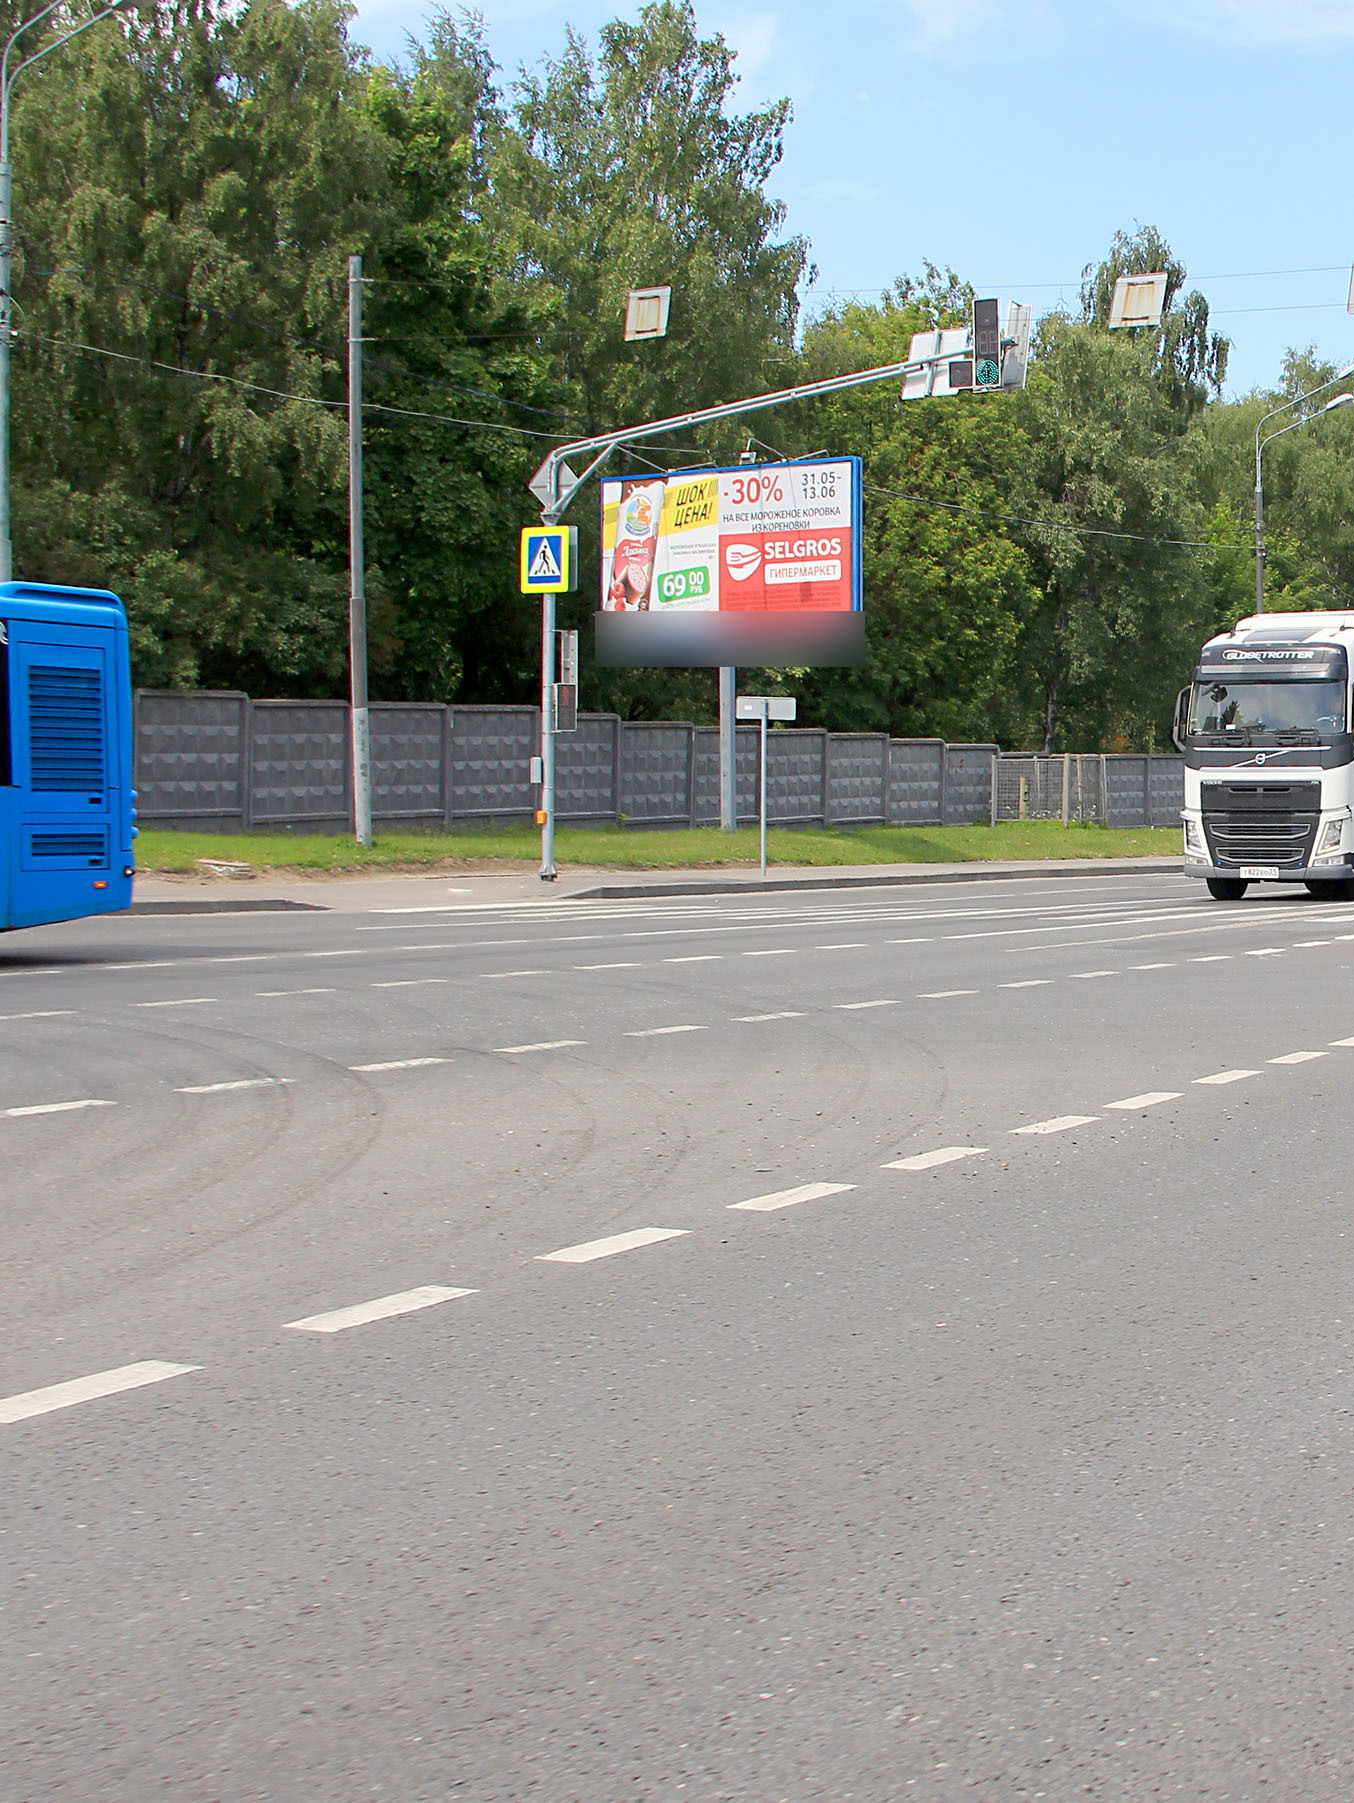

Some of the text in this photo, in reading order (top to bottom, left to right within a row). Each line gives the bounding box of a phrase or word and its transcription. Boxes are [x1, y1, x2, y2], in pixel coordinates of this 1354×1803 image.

[801, 471, 842, 486] 31.05-
[676, 482, 708, 506] ШОК
[723, 475, 783, 505] -30%
[802, 485, 836, 500] 13.06
[674, 502, 713, 528] ЦЕНА!
[723, 506, 841, 523] НА ВСЕ МОРОЖЕНОЕ КОРОВКА
[751, 520, 810, 533] ИЗ КОРЕНОВКИ
[763, 537, 842, 560] SELGROS
[769, 564, 837, 580] ГИПЕРМАРКЕТ
[663, 571, 705, 598] 69 00
[689, 585, 704, 594] РУБ
[1223, 649, 1315, 664] GLOBETROTTER
